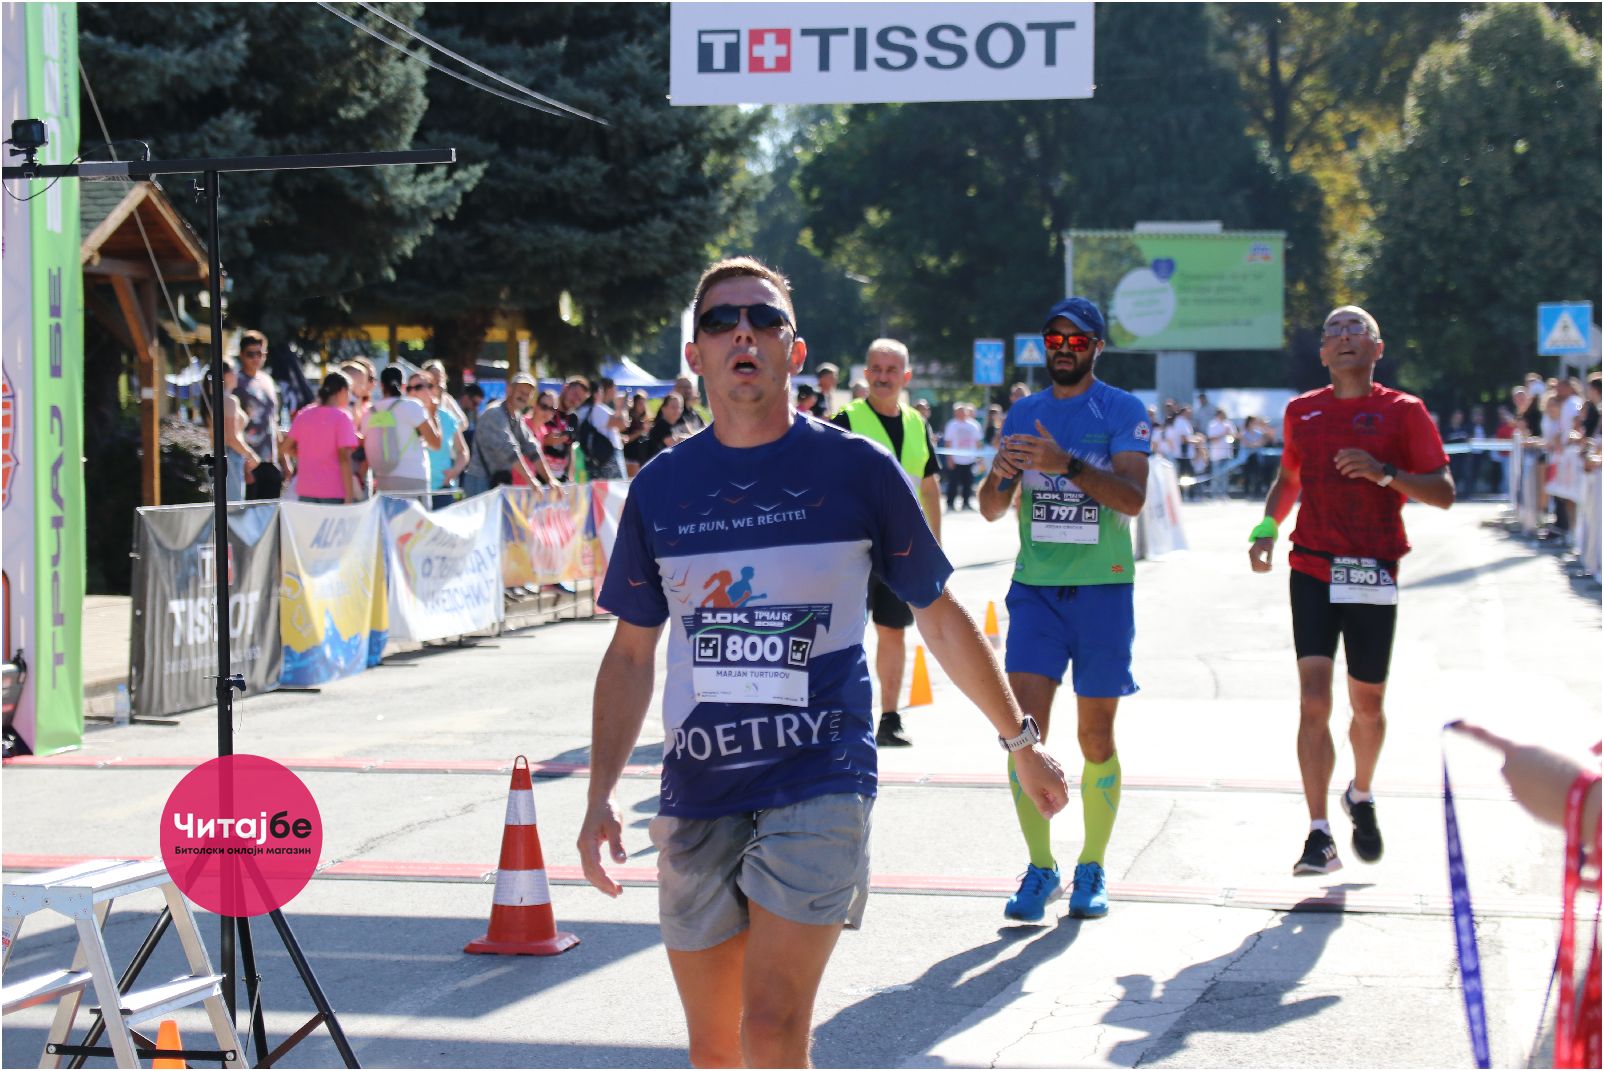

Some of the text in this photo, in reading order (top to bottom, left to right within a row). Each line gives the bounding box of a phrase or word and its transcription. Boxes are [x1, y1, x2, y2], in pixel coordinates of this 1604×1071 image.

[800, 21, 1076, 73] TISSOT
[678, 509, 807, 535] WE RUN, WE RECITE!
[1050, 506, 1078, 521] 797
[1349, 570, 1378, 585] 590
[701, 612, 750, 624] 10K
[725, 634, 784, 662] 800
[716, 670, 790, 680] MARJAN TURTUROV
[673, 710, 843, 761] POETRY RUN
